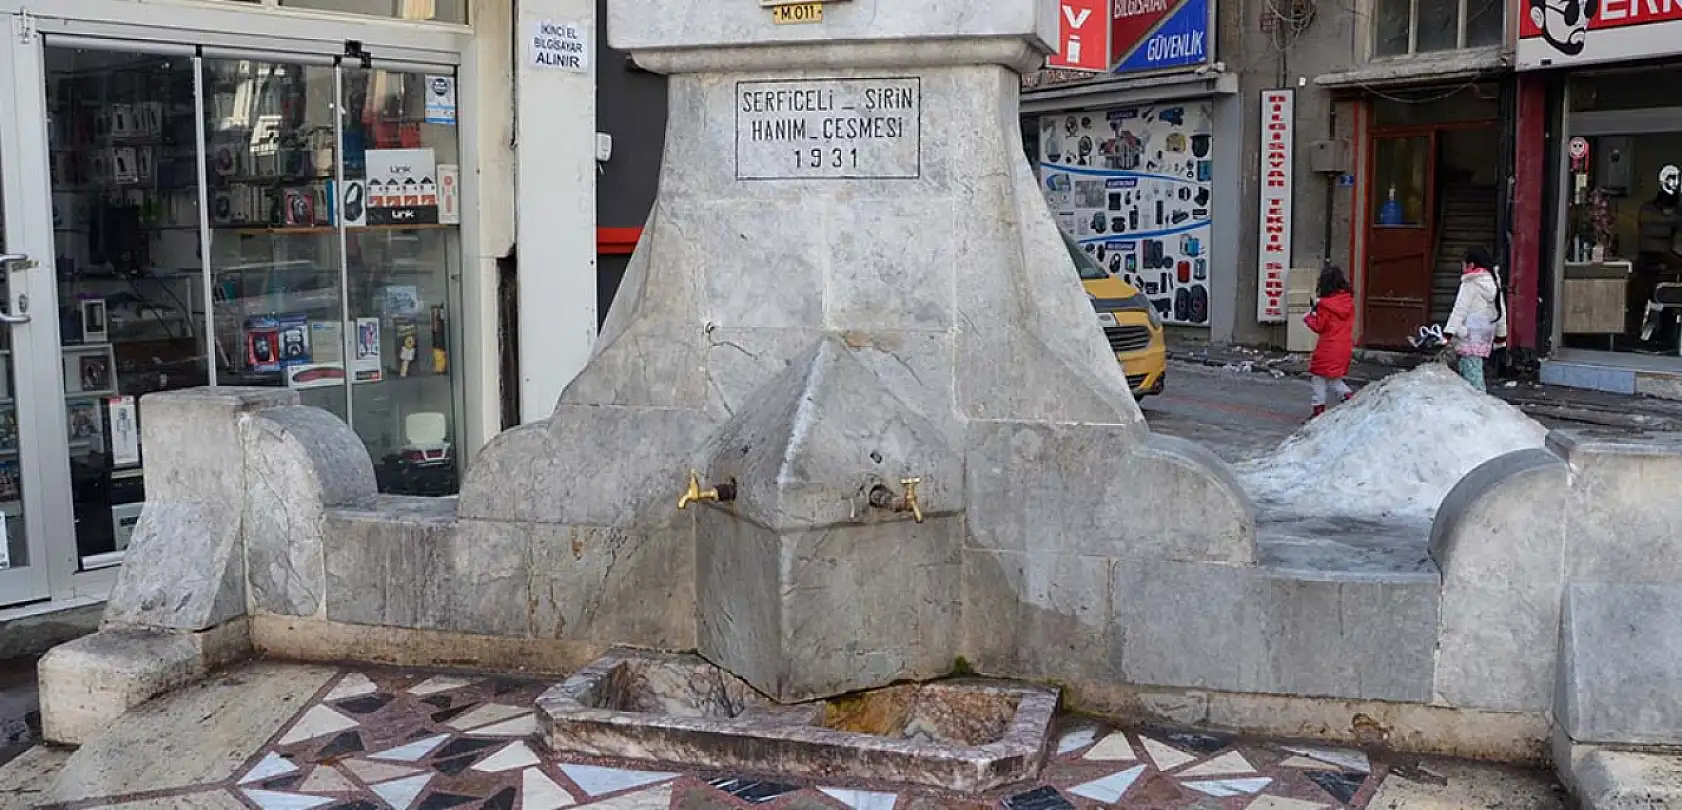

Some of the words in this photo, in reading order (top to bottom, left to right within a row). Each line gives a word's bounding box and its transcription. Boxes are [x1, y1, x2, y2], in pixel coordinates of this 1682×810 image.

[566, 27, 578, 40] EL
[1147, 29, 1204, 60] GÜVENLİK
[535, 51, 580, 69] ALINIR
[794, 146, 858, 169] 1931
